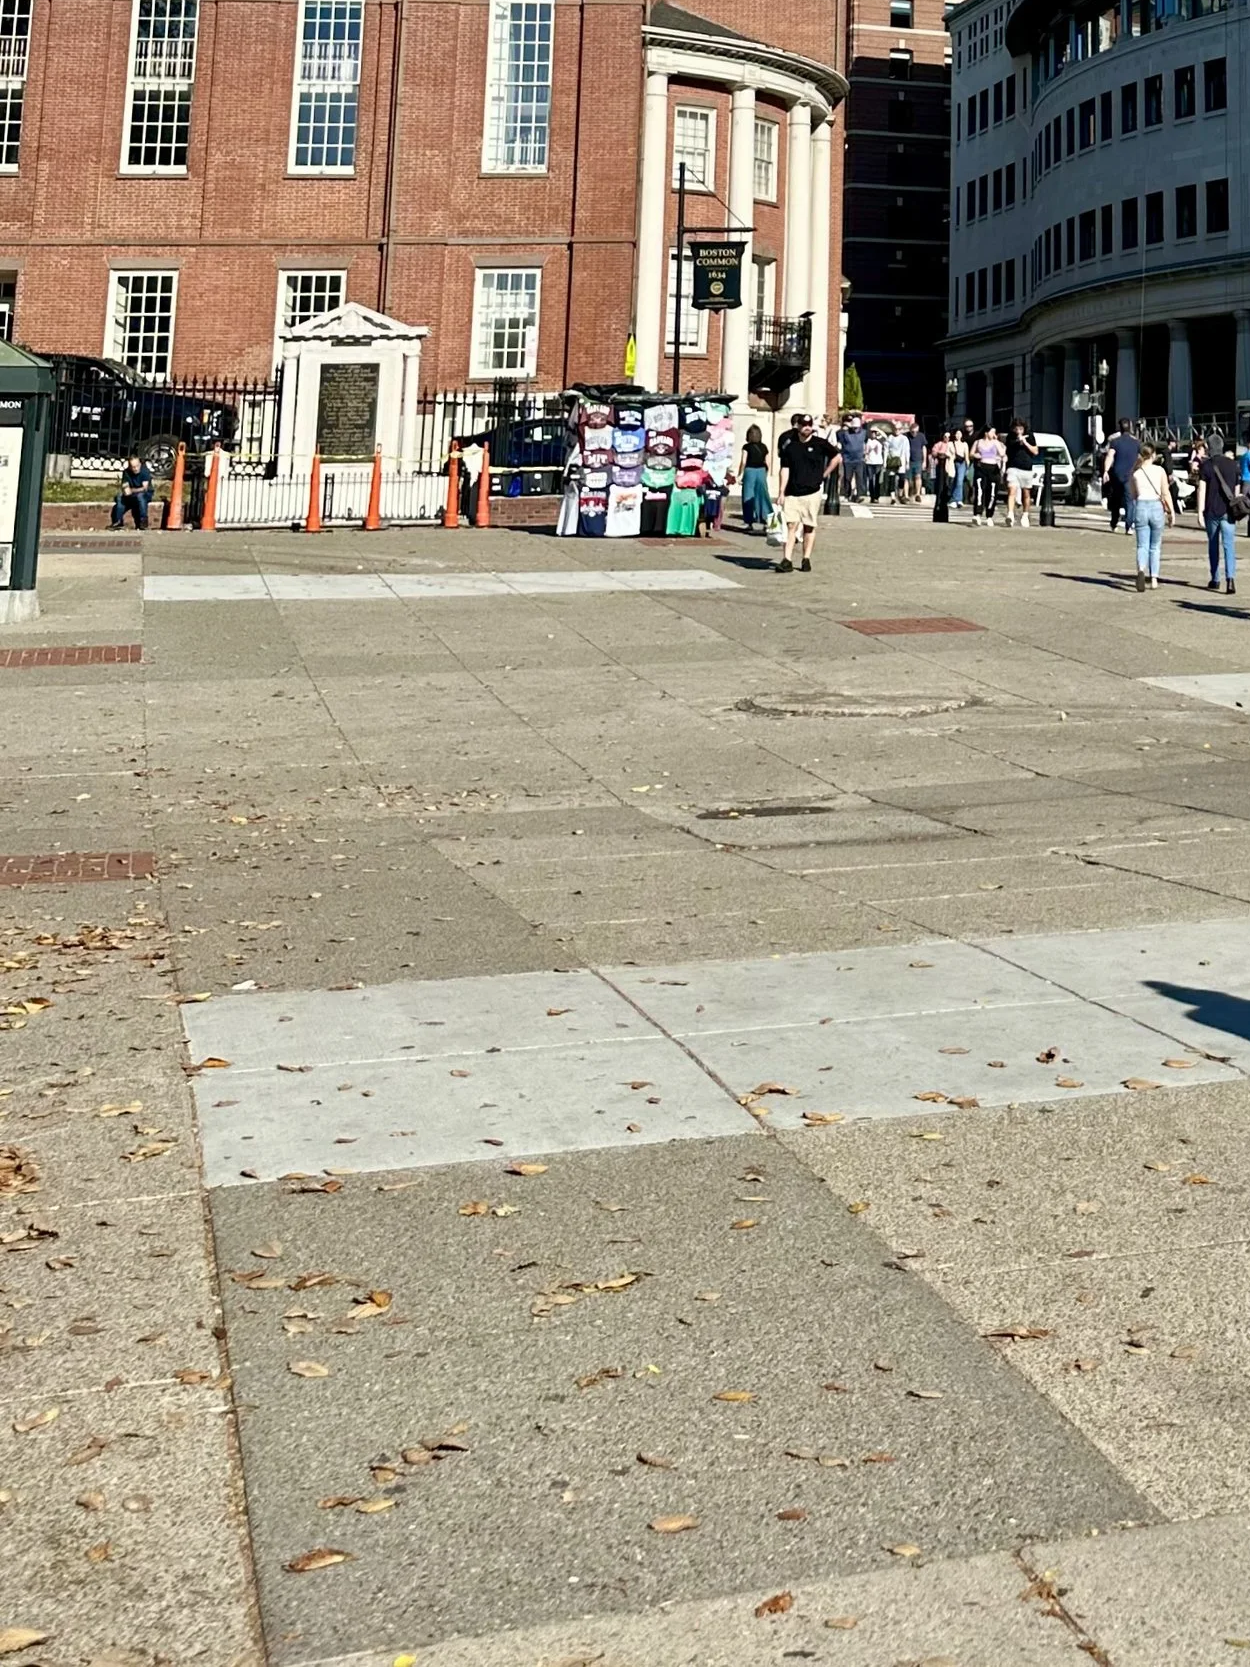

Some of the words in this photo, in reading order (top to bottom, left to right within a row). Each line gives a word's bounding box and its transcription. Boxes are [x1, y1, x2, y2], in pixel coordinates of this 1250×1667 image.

[699, 248, 736, 257] BOSTON
[696, 257, 739, 266] COMMON
[708, 271, 726, 279] 1634
